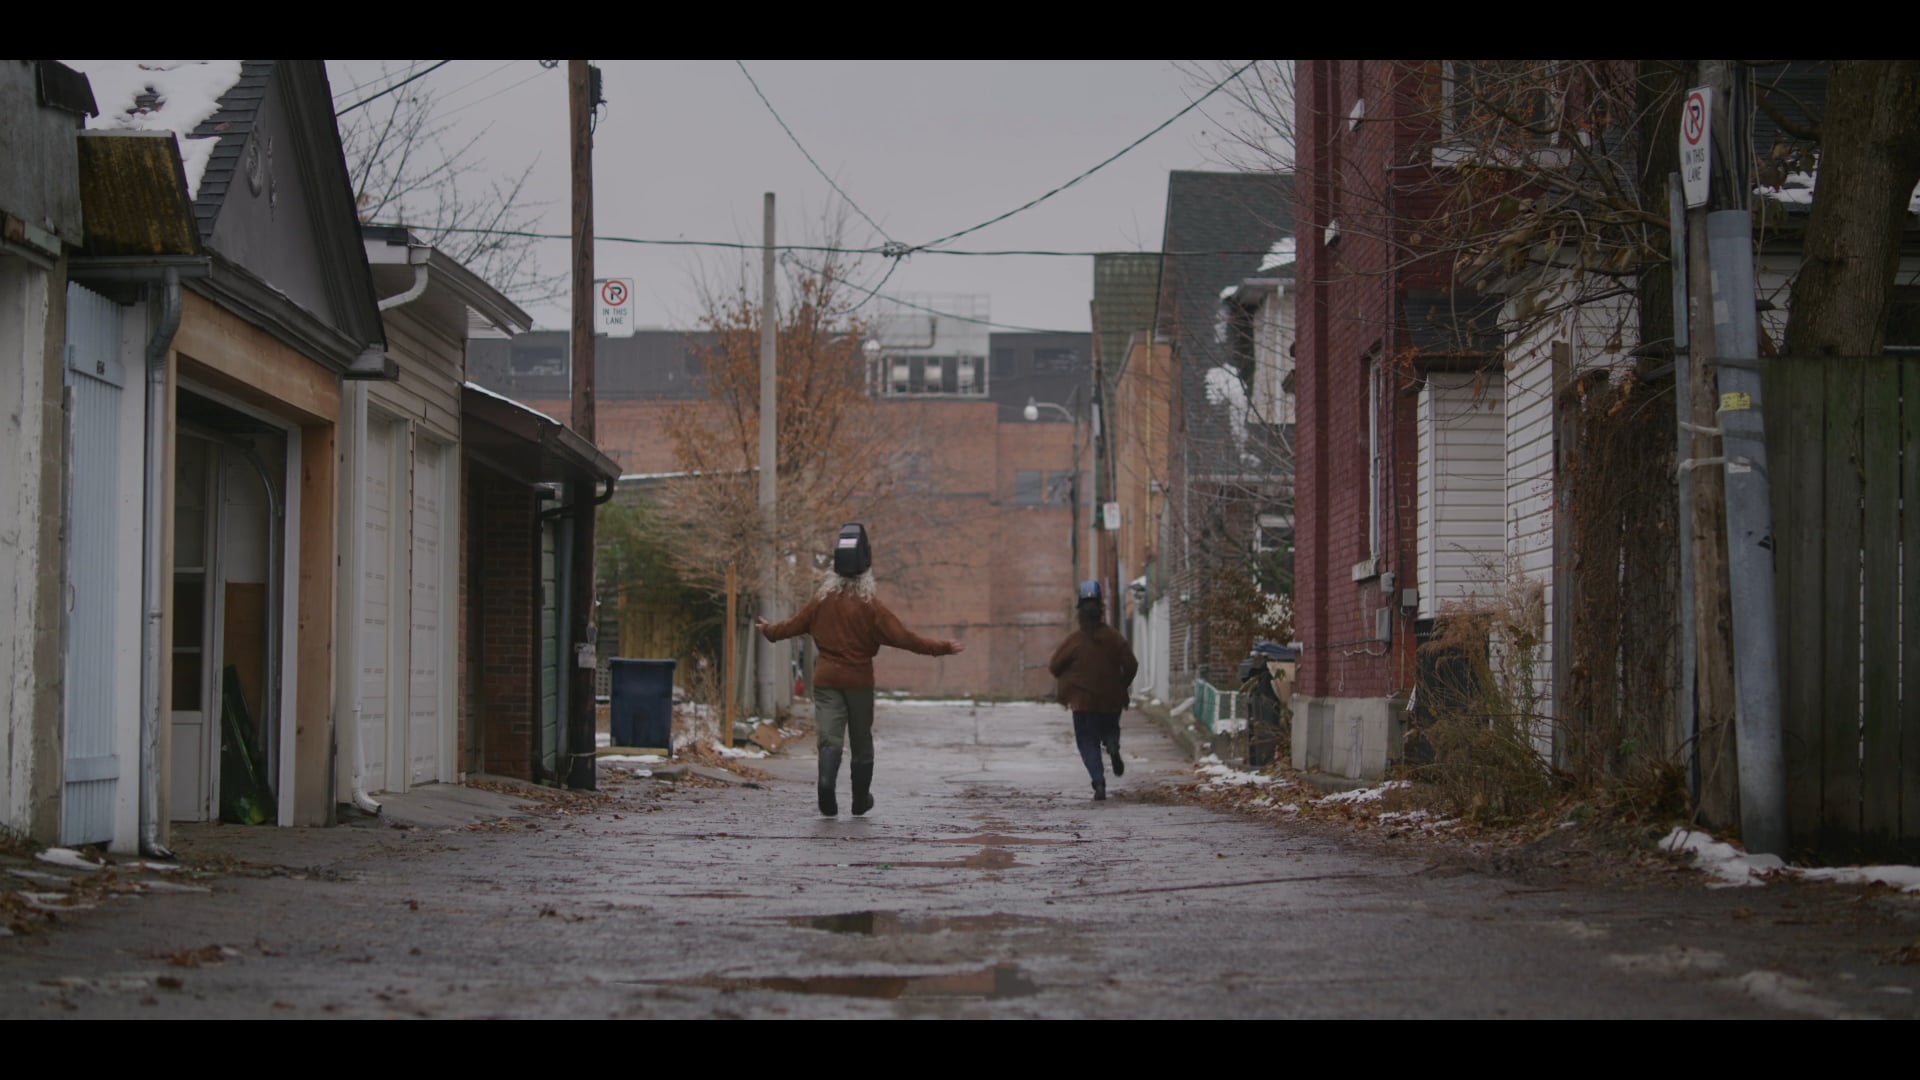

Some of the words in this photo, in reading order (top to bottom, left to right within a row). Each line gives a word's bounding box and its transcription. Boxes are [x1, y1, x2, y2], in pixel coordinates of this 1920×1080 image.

[1685, 150, 1692, 165] IN
[1692, 148, 1704, 164] THIS
[1687, 166, 1702, 183] LANE
[602, 308, 610, 316] IN
[612, 308, 628, 316] THIS
[605, 317, 624, 325] LANE
